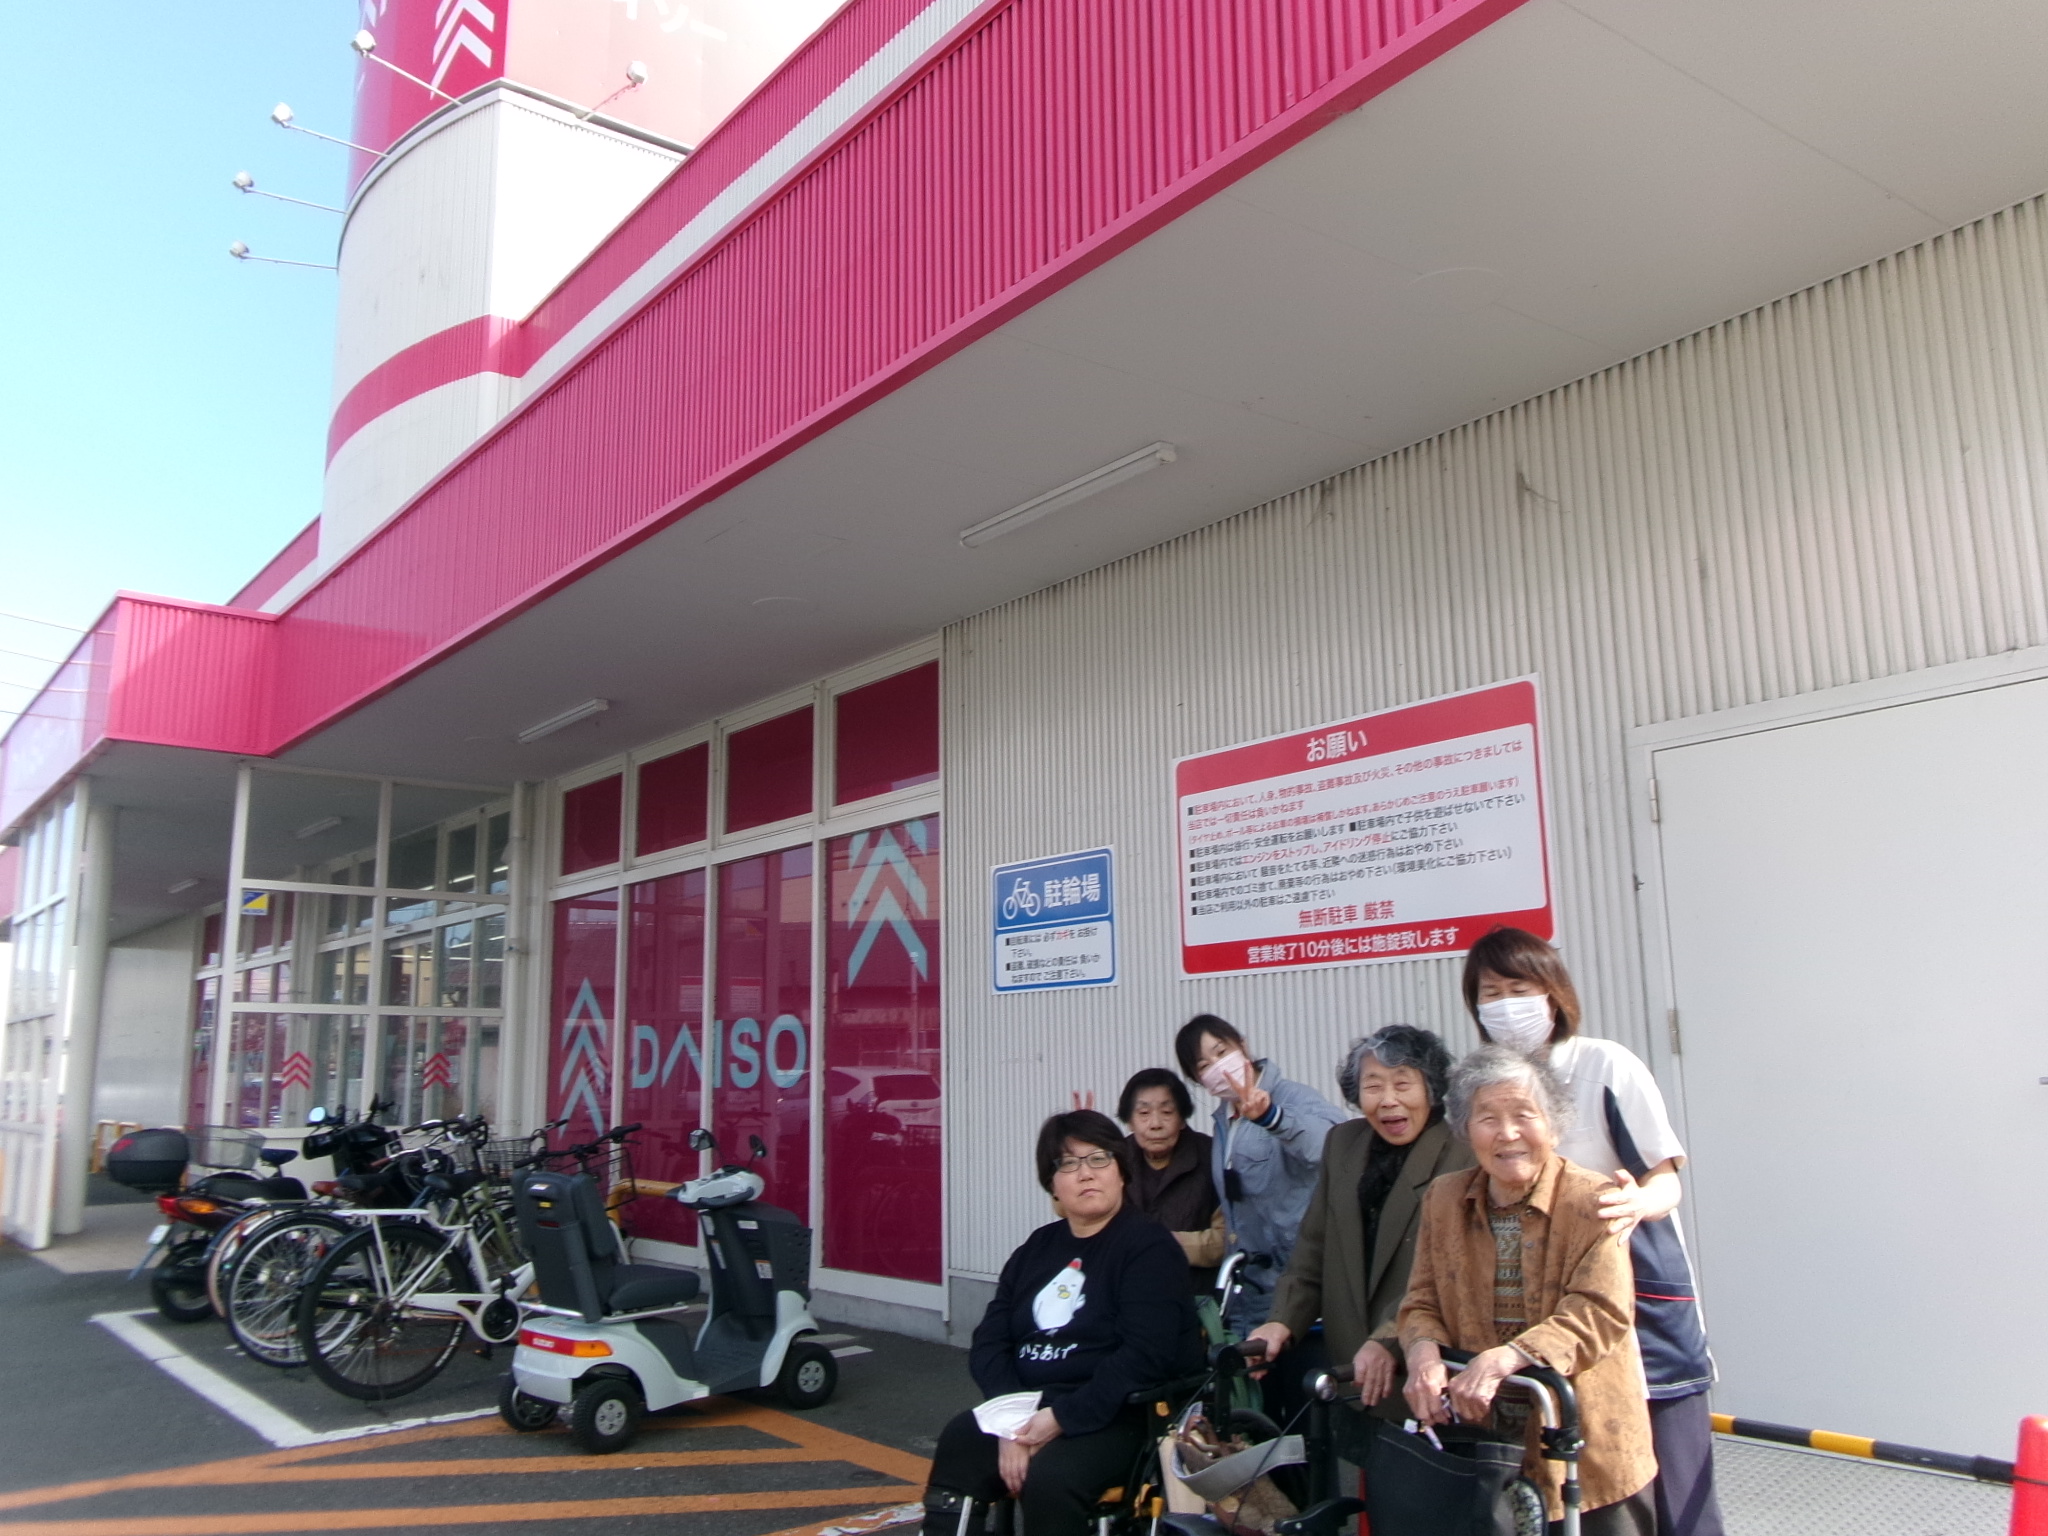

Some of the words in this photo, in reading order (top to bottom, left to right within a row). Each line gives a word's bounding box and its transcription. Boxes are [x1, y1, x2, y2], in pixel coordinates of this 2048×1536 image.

[1306, 726, 1367, 763] お願い
[1043, 872, 1101, 908] 駐輪場
[1298, 904, 1358, 929] 無断駐車
[1363, 899, 1395, 921] 厳禁
[1247, 926, 1459, 964] 営業終了10分後には施錠致します
[631, 1013, 807, 1089] DAISO
